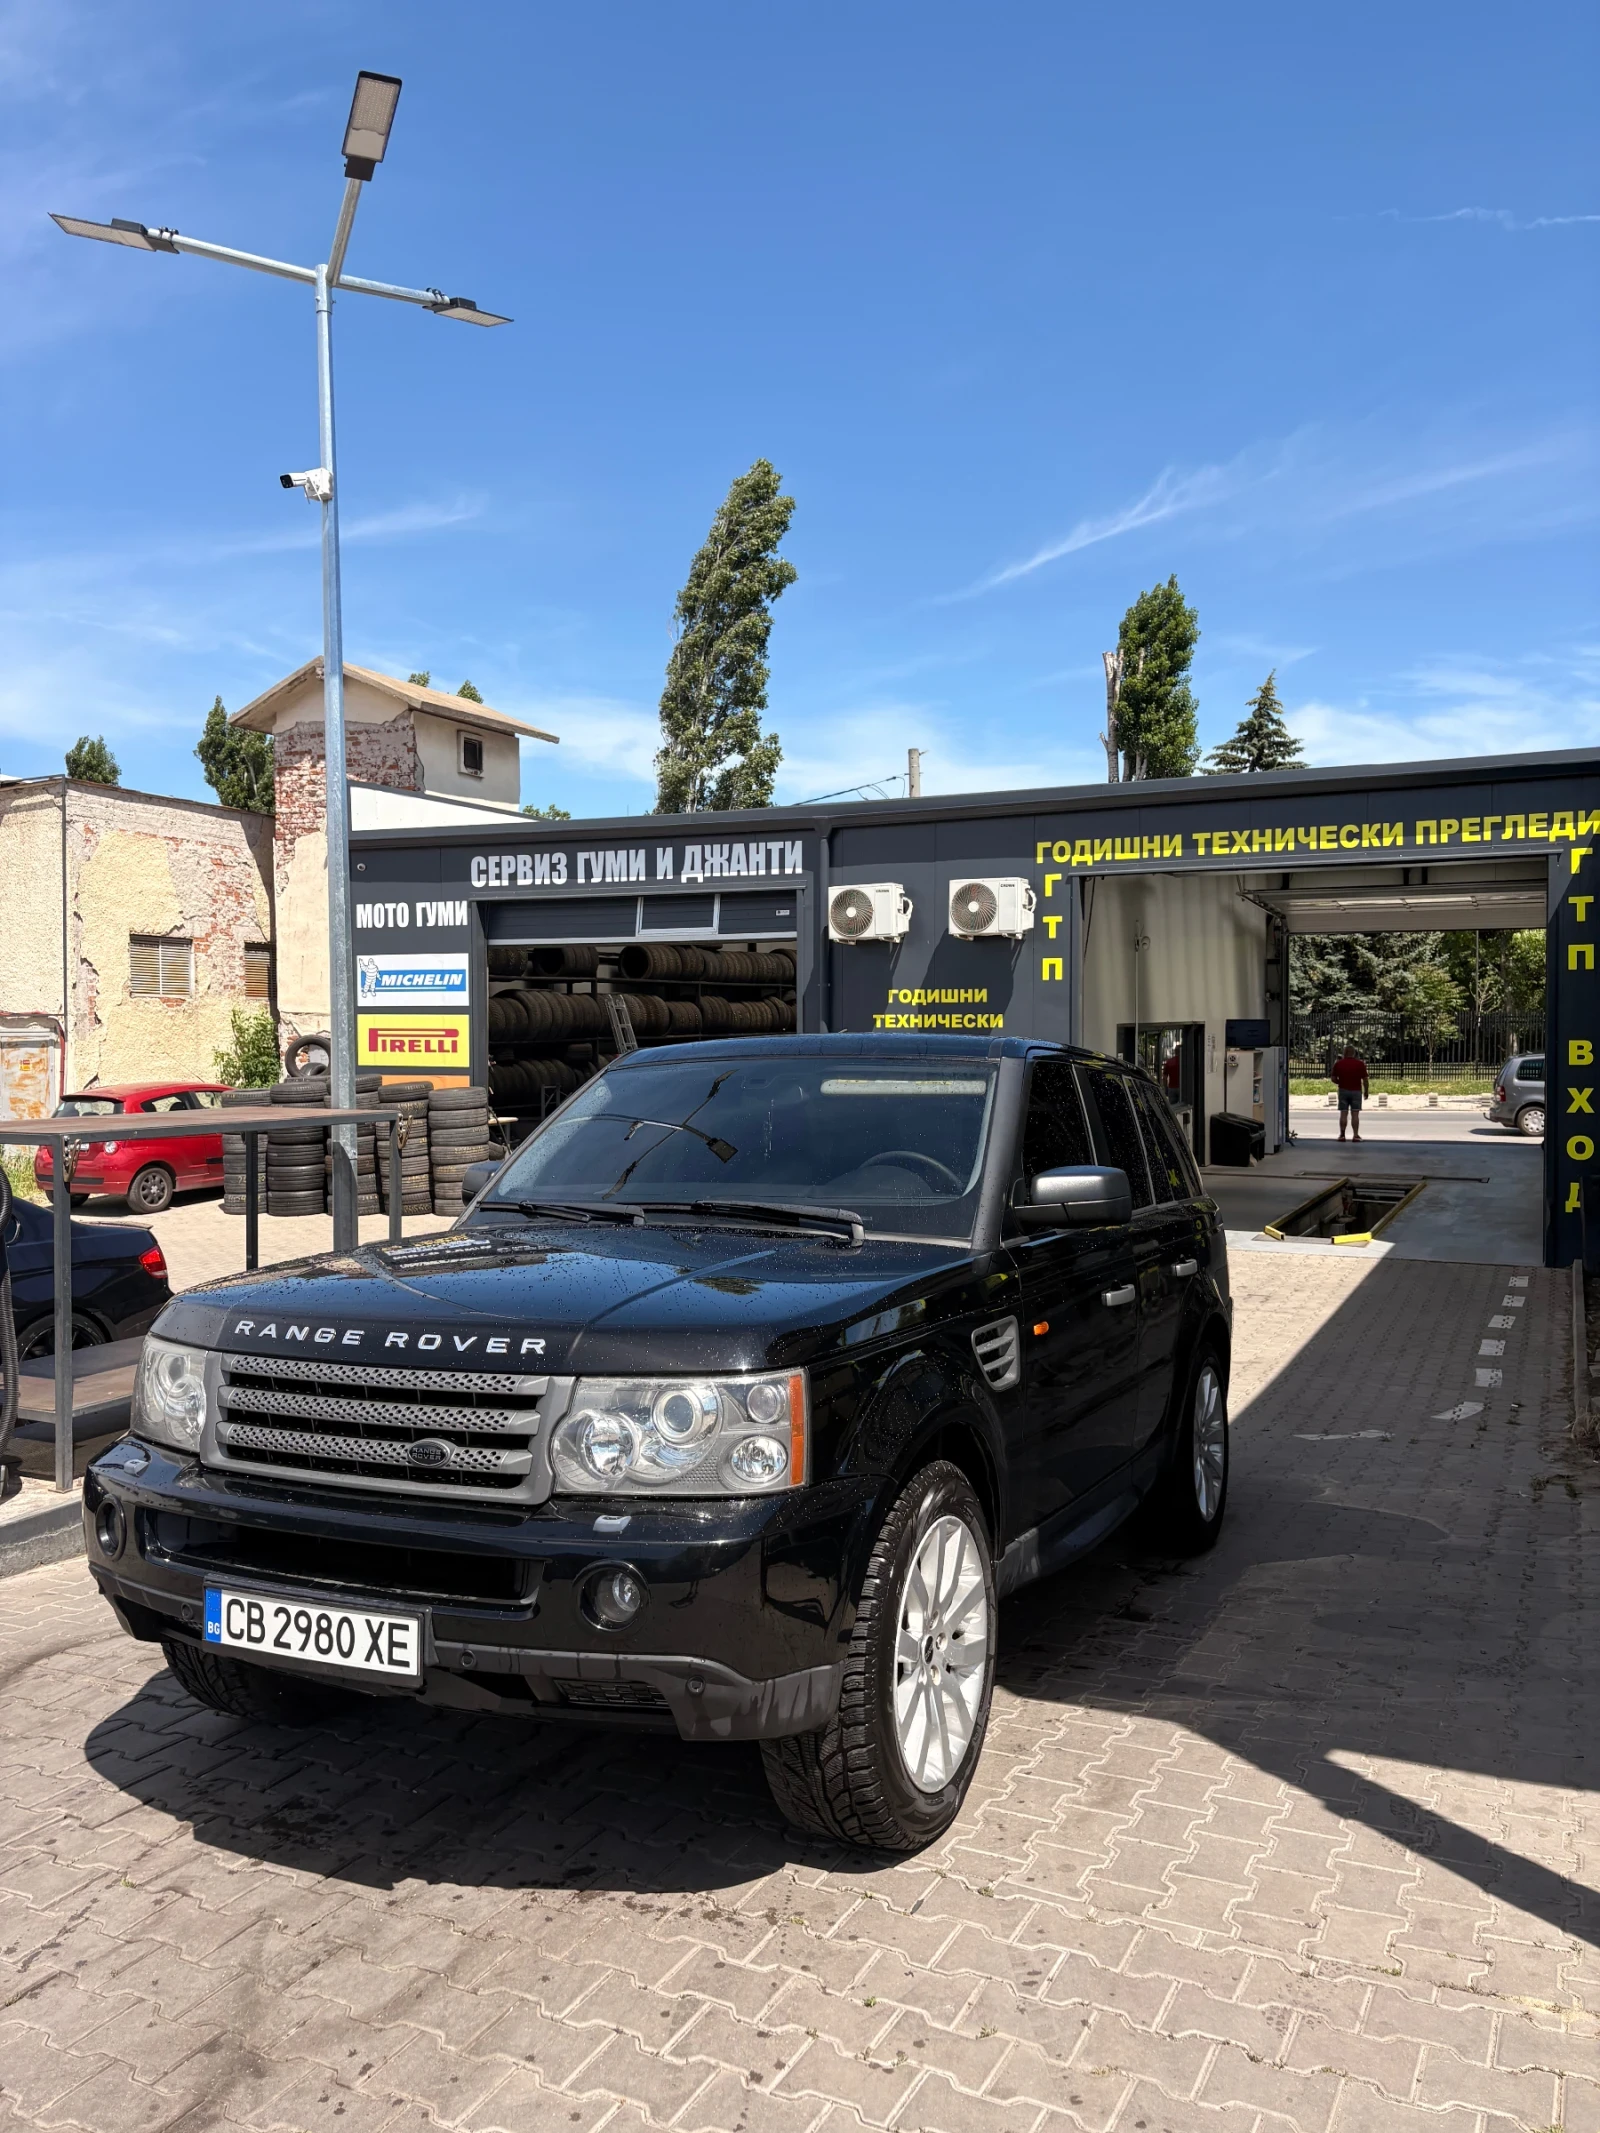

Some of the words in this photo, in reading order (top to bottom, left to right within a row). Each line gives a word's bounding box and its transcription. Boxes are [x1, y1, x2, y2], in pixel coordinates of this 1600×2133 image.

[1036, 834, 1182, 867] ГОДИШНИ
[1192, 822, 1404, 856] ТЕХНИЧЕСКИ
[1415, 809, 1600, 842] ПРЕГЛЕДИ
[470, 852, 568, 888] СЕРВИЗ
[576, 849, 646, 883] ГУМИ
[656, 847, 674, 881] И
[680, 840, 803, 884] ДЖАНТИ
[355, 902, 410, 929] МОТО
[416, 900, 468, 927] ГУМИ
[380, 973, 463, 987] MICHELIN
[888, 988, 988, 1006] ГОДИШНИ
[873, 1013, 1004, 1030] ТЕХНИЧЕСКИ
[368, 1027, 459, 1053] PIRELLI
[234, 1320, 366, 1346] RANGE
[384, 1331, 547, 1355] ROVER
[411, 1447, 442, 1455] RANGE
[411, 1452, 442, 1460] ROVER
[207, 1621, 220, 1635] BG
[226, 1598, 266, 1645] CB
[273, 1606, 356, 1660] 2980
[364, 1618, 411, 1669] XE
